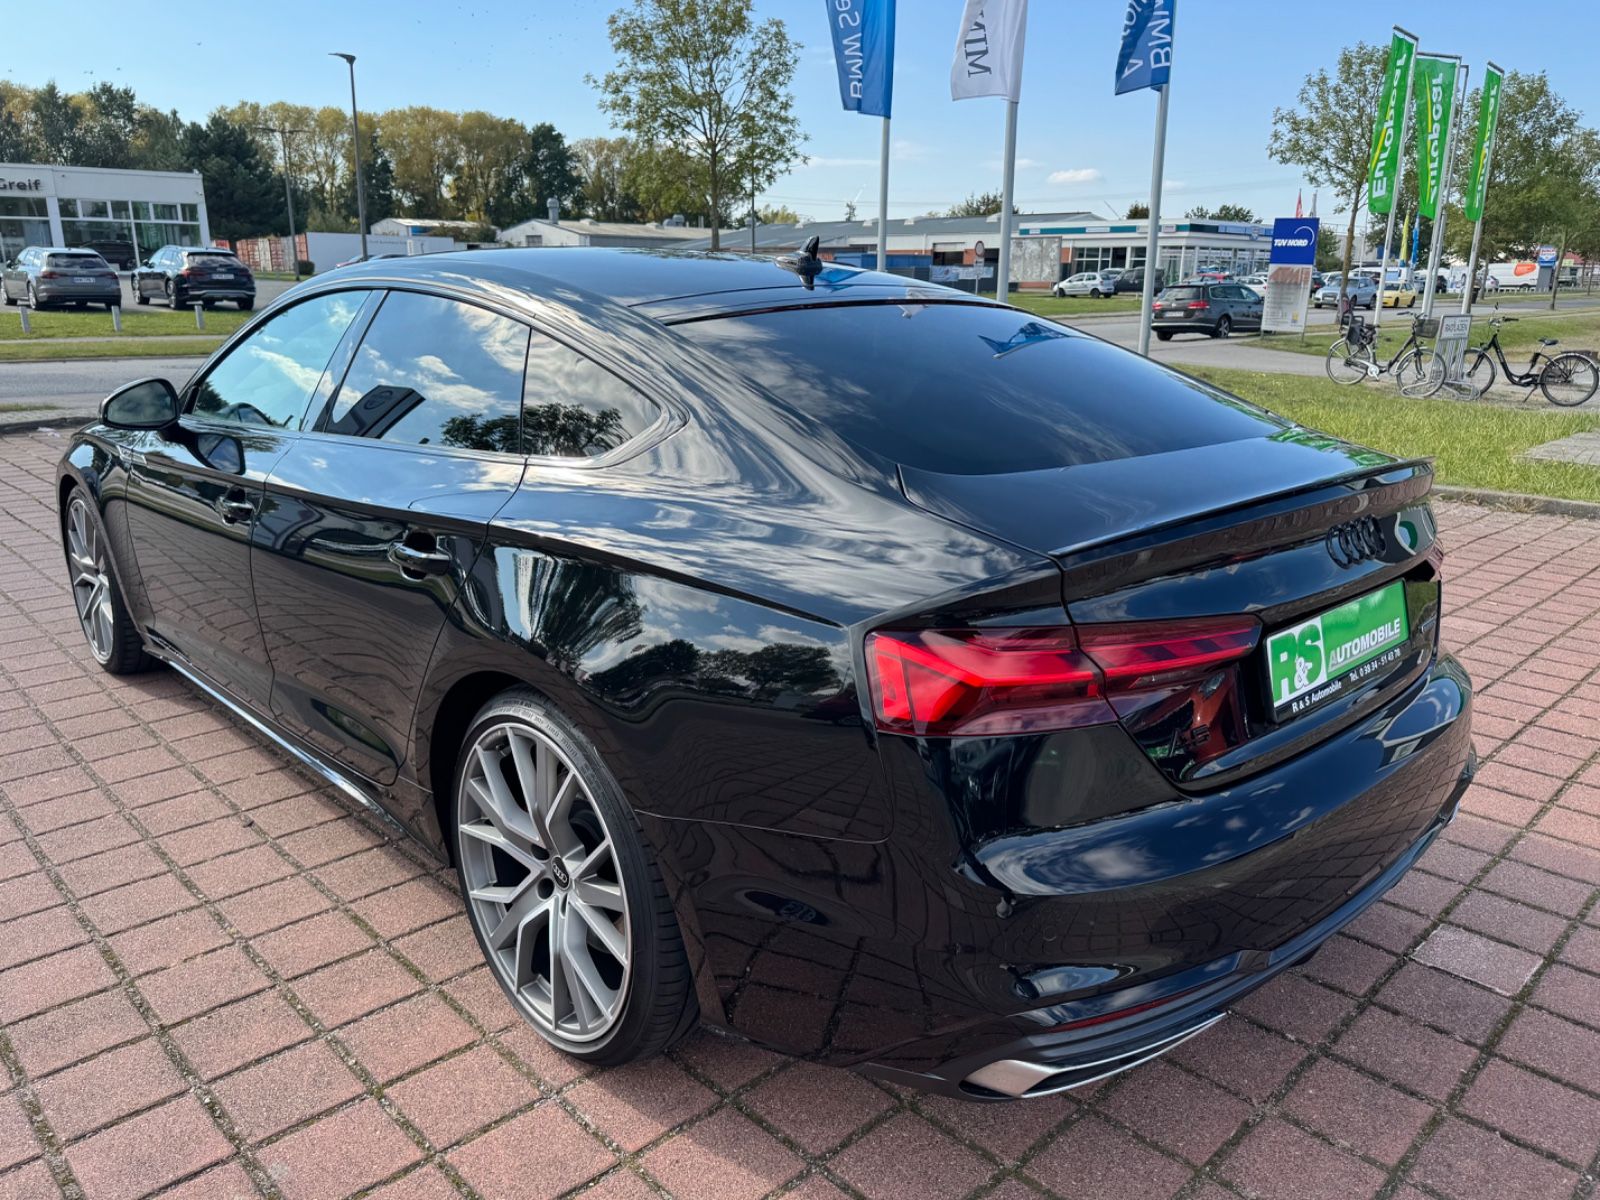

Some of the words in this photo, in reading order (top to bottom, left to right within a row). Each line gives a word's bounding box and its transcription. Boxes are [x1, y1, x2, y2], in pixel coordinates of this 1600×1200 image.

[0, 178, 41, 191] Greif
[1329, 617, 1400, 667] AUTOMOBILE
[1292, 701, 1299, 713] R
[1304, 695, 1310, 706] S
